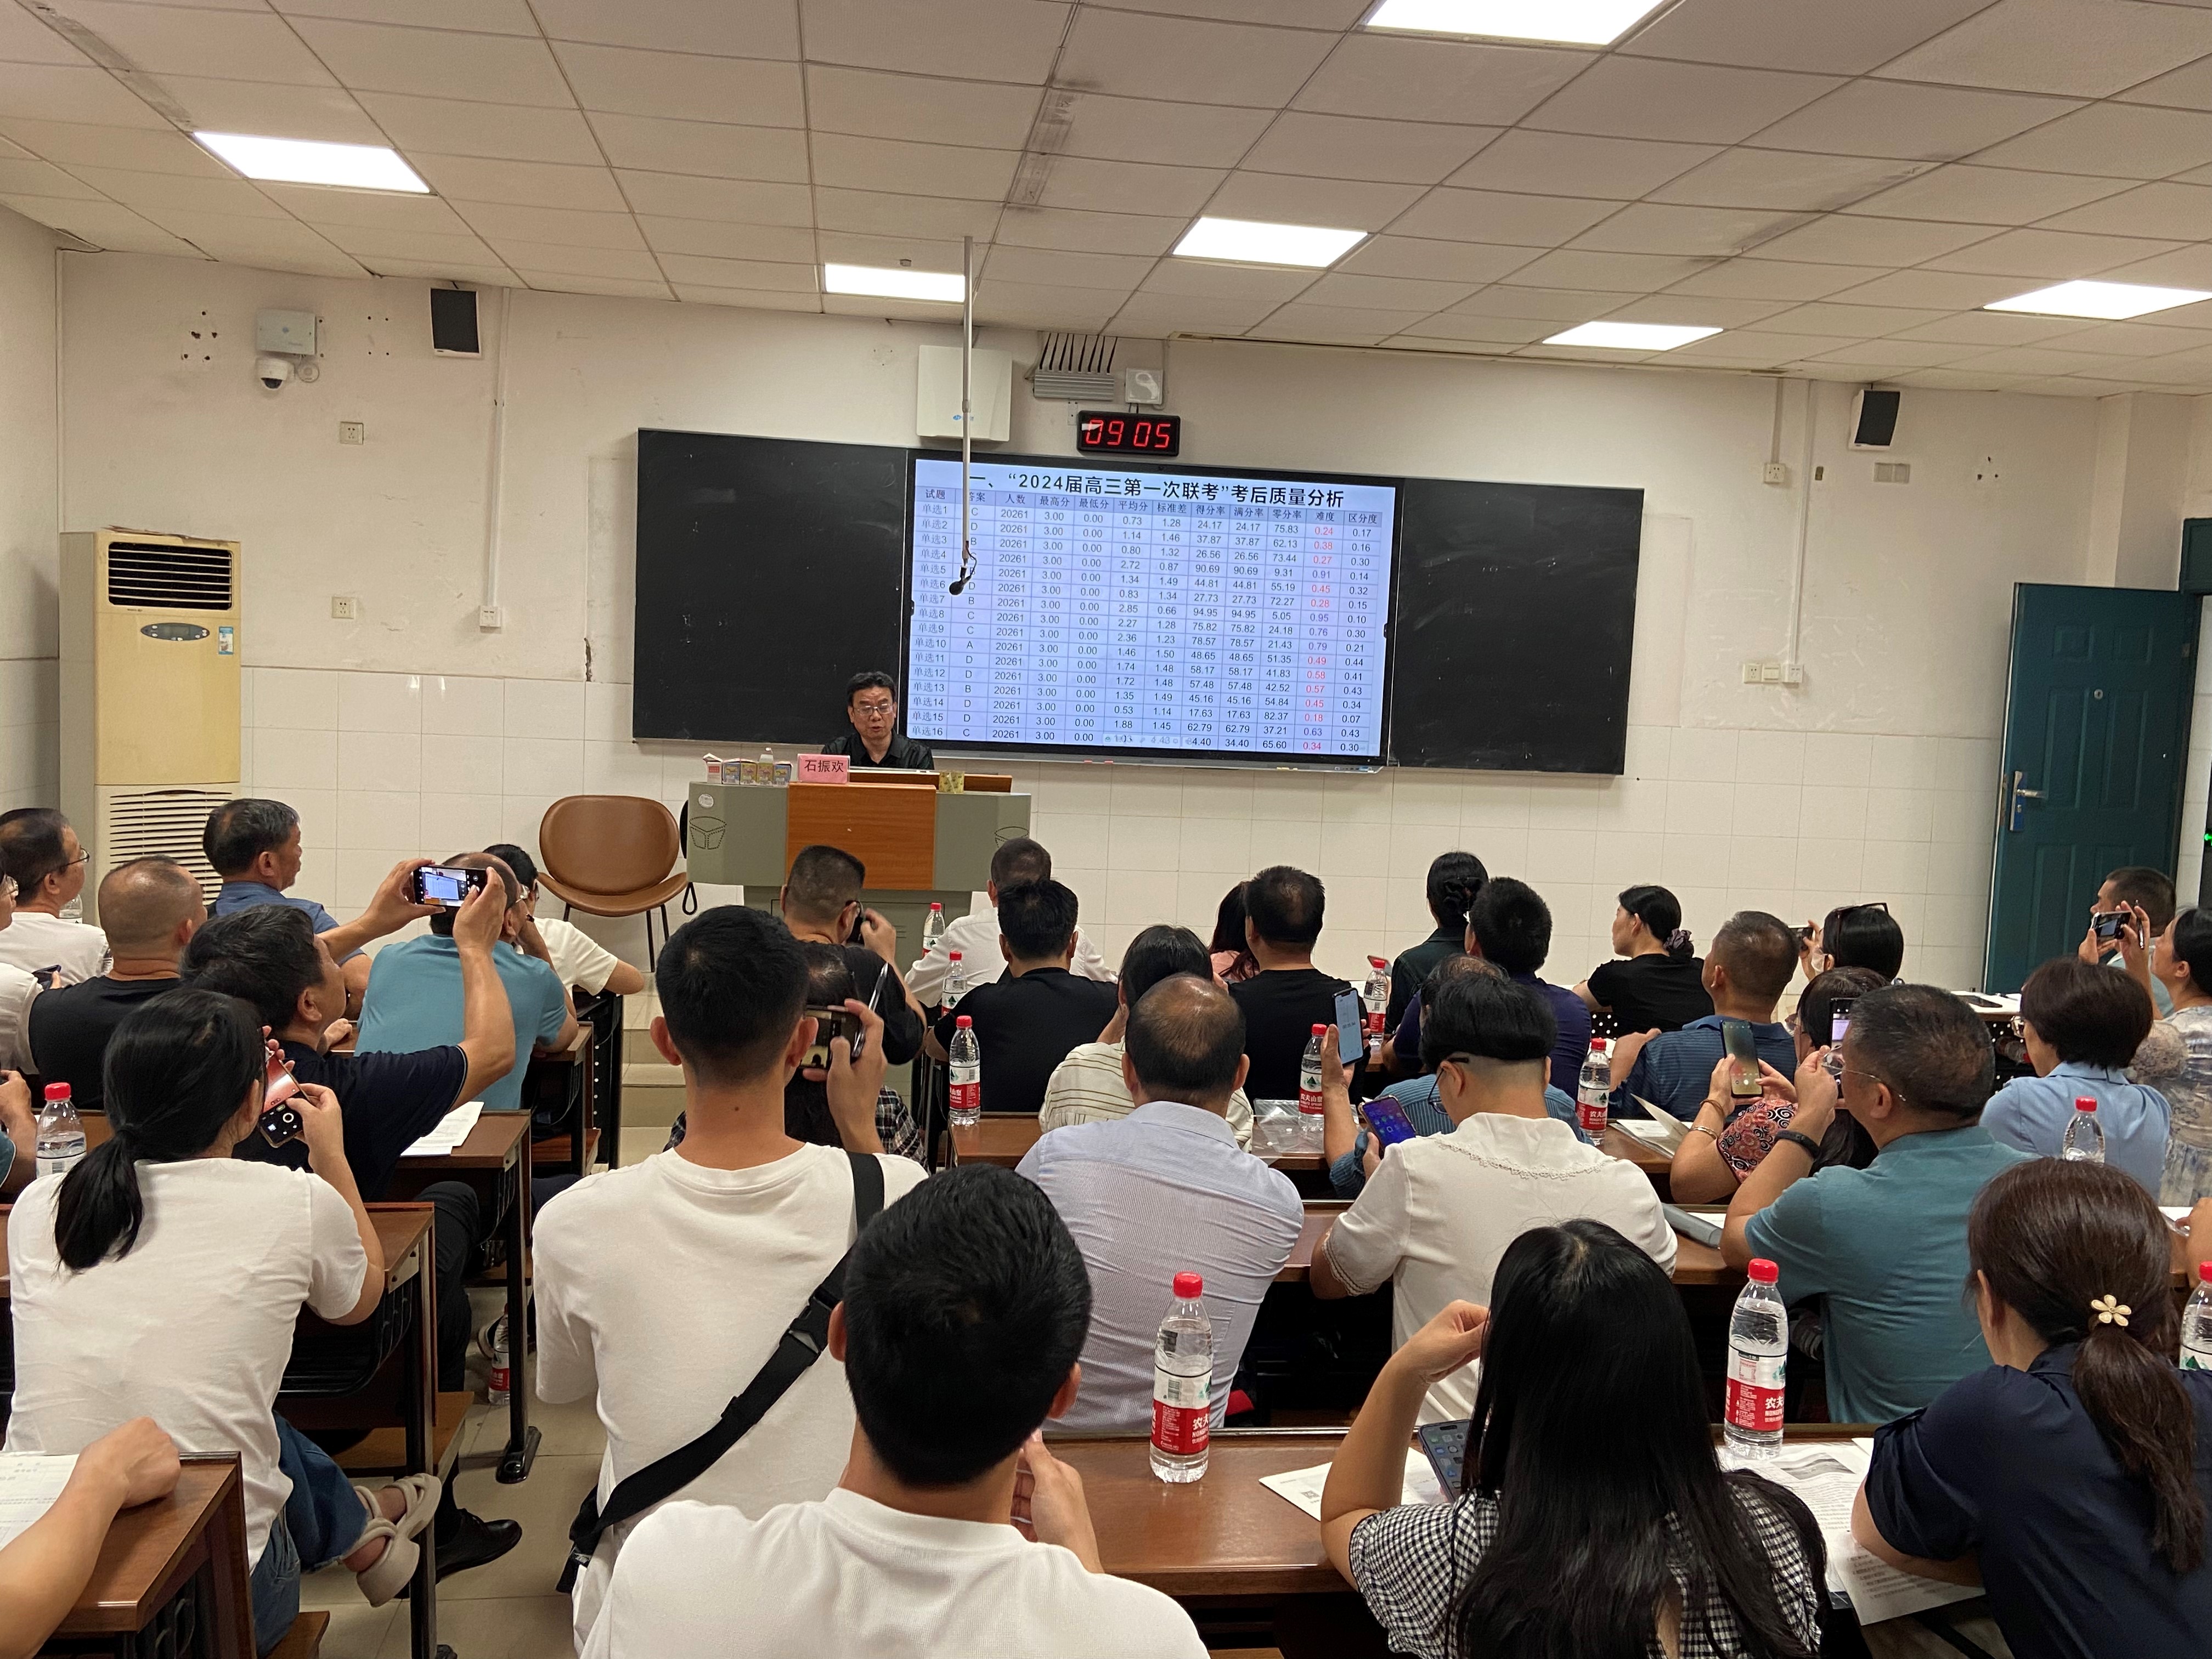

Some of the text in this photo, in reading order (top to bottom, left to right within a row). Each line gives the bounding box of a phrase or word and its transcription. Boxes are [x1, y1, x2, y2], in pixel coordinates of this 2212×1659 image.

[926, 489, 945, 499] 试题
[1005, 493, 1025, 504] 人数
[1040, 494, 1070, 506] 最高分
[1079, 498, 1109, 509] 最低分
[1118, 499, 1149, 511] 平均分
[1157, 502, 1186, 514] 标准差
[1196, 504, 1224, 515] 得分率
[1234, 507, 1263, 517] 满分率
[1272, 509, 1301, 519] 零分率
[1317, 511, 1334, 521] 难度
[1348, 513, 1376, 524] 区分度
[1001, 509, 1371, 537] 20261 3.00 0.00 24.17 24.17 75.83 0.17
[1197, 535, 1370, 552] 37.87 37.87 62.13 0.16
[1196, 549, 1369, 566] 26.56 26.56 73.44 0.30
[1195, 564, 1368, 580] 90.69 90.69 9.31 0.14
[1194, 579, 1368, 595] 44.81 44.81 55.19 0.32
[968, 596, 1366, 623] B 20261 3.00 0.00 2.85 0.66 94.95 94.95 5.05 0.10
[1194, 593, 1367, 609] 27.73 27.73 72.27 0.15
[967, 611, 1365, 638] C 20261 3.00 0.00 2.27 1.28 75.82 75.82 24.18 0.30
[967, 626, 974, 634] C
[996, 628, 1023, 636] 20261
[1040, 629, 1059, 638] 3.00
[1079, 631, 1098, 640] 0.00
[1118, 633, 1136, 642] 2.36
[1158, 635, 1175, 644] 1.23
[1192, 636, 1216, 645] 78.57
[1231, 639, 1254, 647] 78.57
[1268, 640, 1292, 649] 21.43
[916, 637, 946, 648] 单选10
[996, 642, 1022, 651] 20261
[1039, 644, 1058, 653] 3.00
[1078, 646, 1097, 654] 0.00
[1119, 648, 1136, 656] 1.46
[1156, 650, 1174, 658] 1.50
[1191, 651, 1215, 660] 48.65
[1229, 653, 1253, 662] 48.65
[1267, 654, 1291, 663] 51.35
[1345, 658, 1363, 666] 0.44
[915, 652, 945, 662] 单选11
[995, 657, 1022, 665] 20261
[1039, 658, 1058, 667] 3.00
[1077, 661, 1097, 669] 0.00
[1117, 662, 1135, 670] 1.74
[1156, 664, 1173, 672] 1.48
[1190, 665, 1215, 674] 58.17
[1228, 667, 1252, 676] 58.17
[1344, 672, 1362, 680] 0.41
[915, 667, 1362, 695] 单选12 D 20261 3.00 0.00 1.72 1.48 57.48 57.48 42.52 0.43
[914, 681, 1361, 709] 单选13 B 20261 3.00 0.00 1.35 1.49 45.16 45.16 54.84 0.34
[913, 696, 943, 707] 单选14
[993, 701, 1019, 709] 20261
[1036, 703, 1056, 711] 3.00
[1076, 704, 1094, 713] 0.00
[1114, 706, 1133, 714] 0.53
[1154, 707, 1171, 715] 1.14
[1189, 709, 1212, 717] 17.63
[1228, 710, 1250, 719] 17.63
[1264, 712, 1288, 720] 82.37
[1342, 715, 1361, 723] 0.07
[913, 711, 943, 721] 单选15
[963, 714, 970, 722] D
[993, 715, 1019, 724] 20261
[1036, 716, 1055, 725] 3.00
[1075, 719, 1094, 727] 0.00
[1153, 721, 1171, 730] 1.45
[1187, 723, 1211, 732] 62.79
[1226, 725, 1250, 733] 62.79
[1263, 726, 1286, 734] 37.21
[1341, 729, 1359, 737] 0.43
[912, 726, 943, 736] 单选16
[992, 730, 1018, 738] 20261
[1035, 731, 1054, 740] 3.00
[1074, 733, 1093, 741] 0.00
[1225, 738, 1249, 747] 34.40
[1262, 740, 1286, 748] 65.60
[1340, 743, 1359, 752] 0.30
[804, 760, 844, 772] 石振欢
